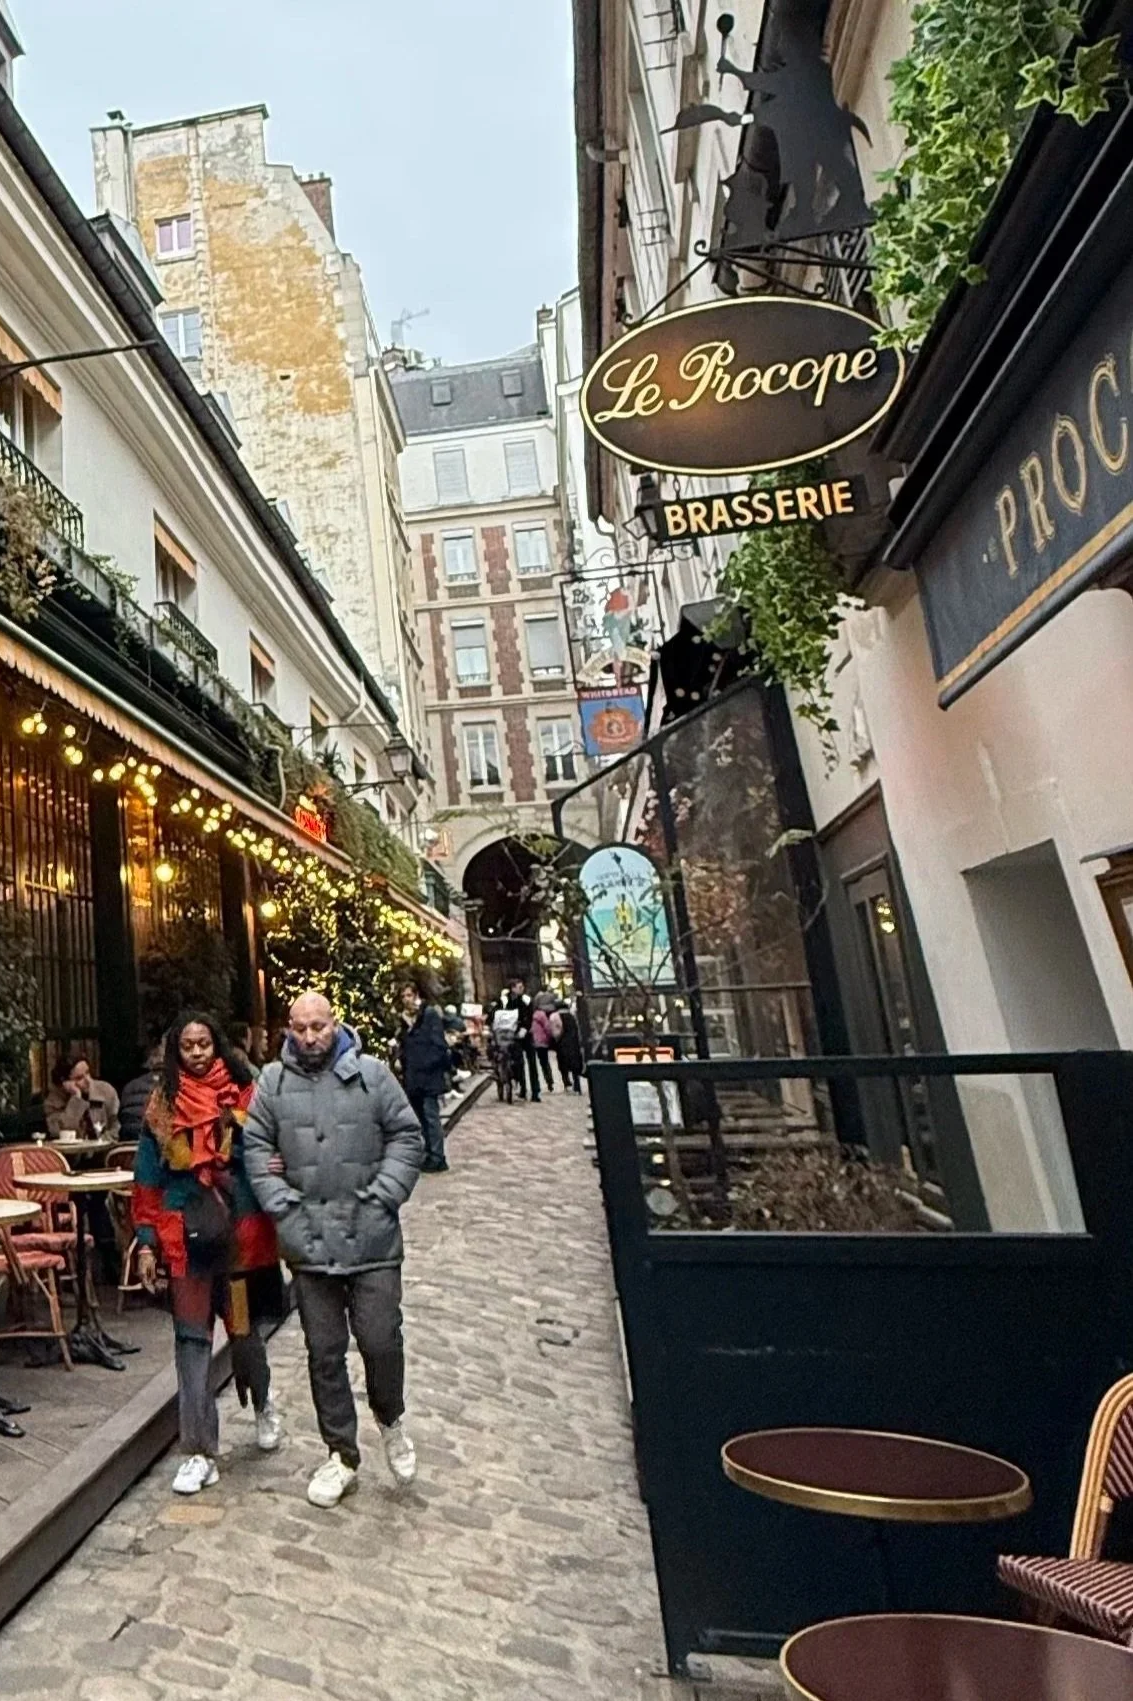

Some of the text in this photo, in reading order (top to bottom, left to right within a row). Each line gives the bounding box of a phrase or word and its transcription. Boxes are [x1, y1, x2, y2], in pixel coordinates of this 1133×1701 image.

[594, 340, 878, 423] Le Procope
[995, 328, 1133, 578] PROC
[663, 480, 855, 537] BRASSERIE
